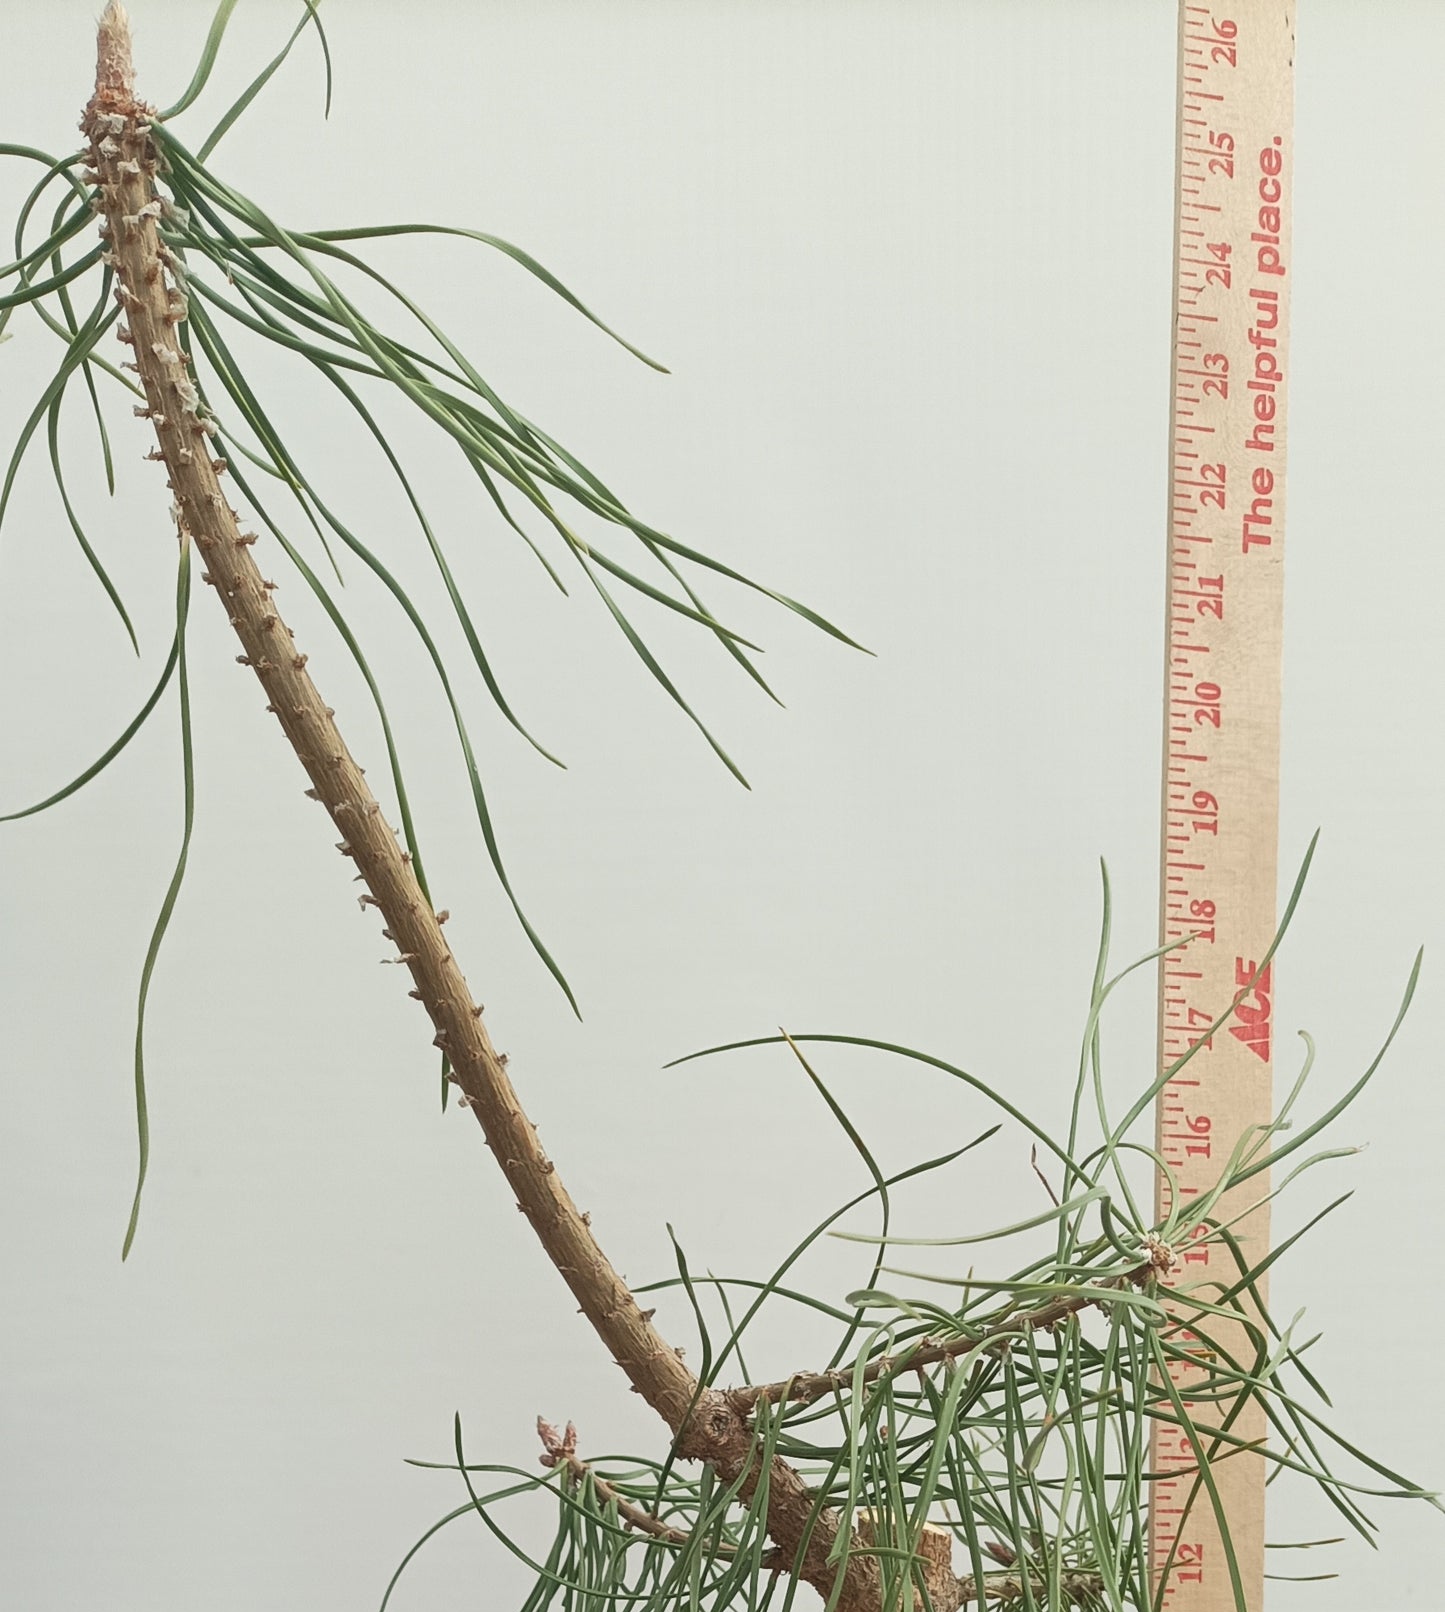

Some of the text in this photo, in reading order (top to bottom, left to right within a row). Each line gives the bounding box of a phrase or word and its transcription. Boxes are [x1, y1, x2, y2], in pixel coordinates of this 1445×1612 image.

[1211, 18, 1238, 68] 26
[1208, 131, 1236, 179] 25
[1205, 242, 1232, 289] 24
[1242, 135, 1286, 553] The helpful place.
[1202, 353, 1229, 400] 23
[1200, 463, 1227, 510] 22
[1197, 574, 1224, 620] 21
[1194, 681, 1221, 728] 20
[1191, 790, 1219, 836] 19
[1189, 898, 1216, 944] 18
[1228, 956, 1272, 1063] ACE
[1185, 1115, 1212, 1159] 16
[1177, 1543, 1203, 1584] 12
